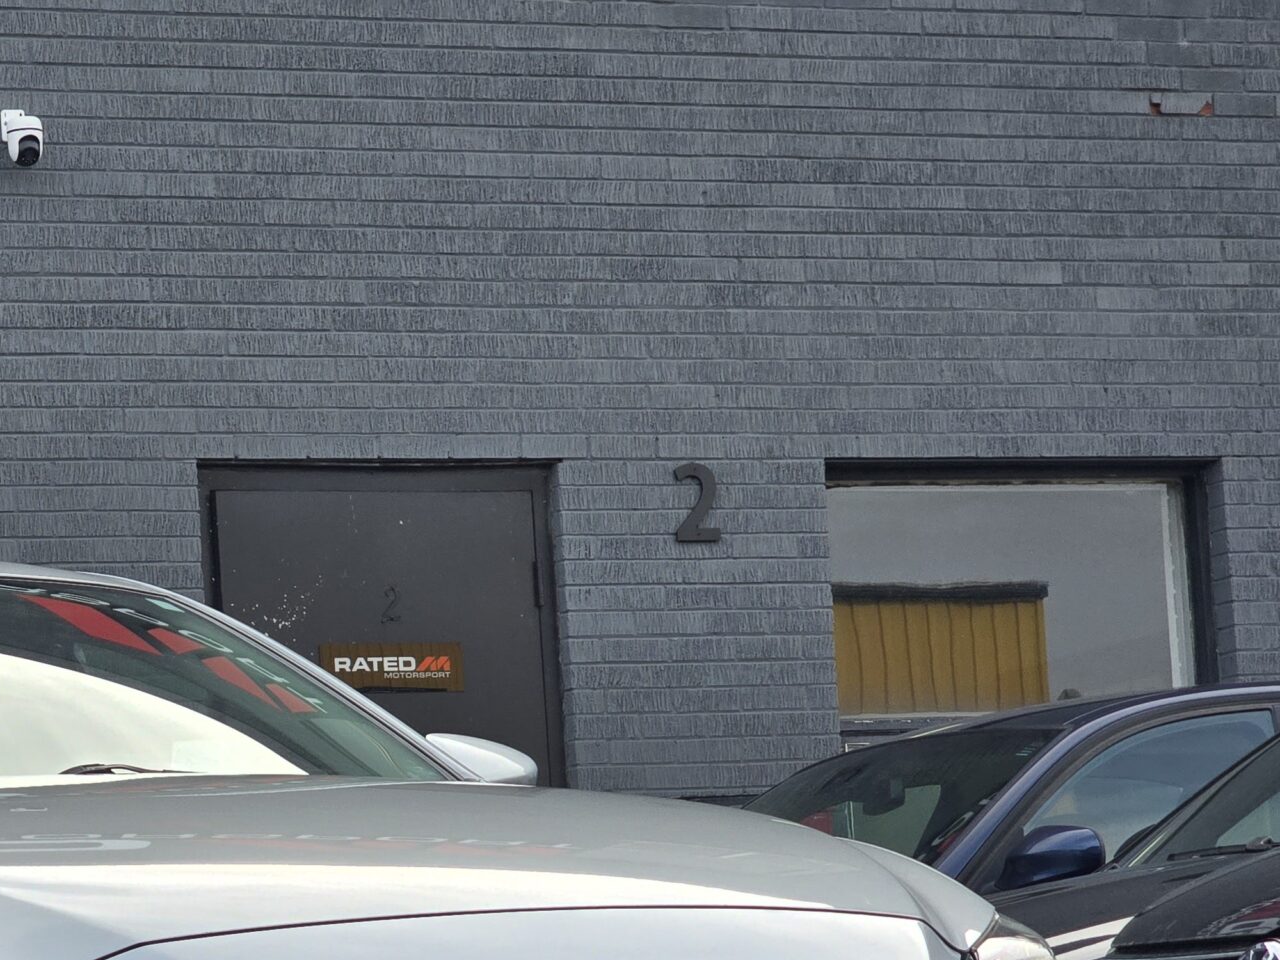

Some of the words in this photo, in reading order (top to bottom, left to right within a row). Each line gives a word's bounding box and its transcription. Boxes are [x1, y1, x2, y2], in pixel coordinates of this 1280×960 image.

[673, 462, 721, 543] 2
[333, 656, 417, 672] RATED
[383, 671, 451, 679] MOTORSPORT
